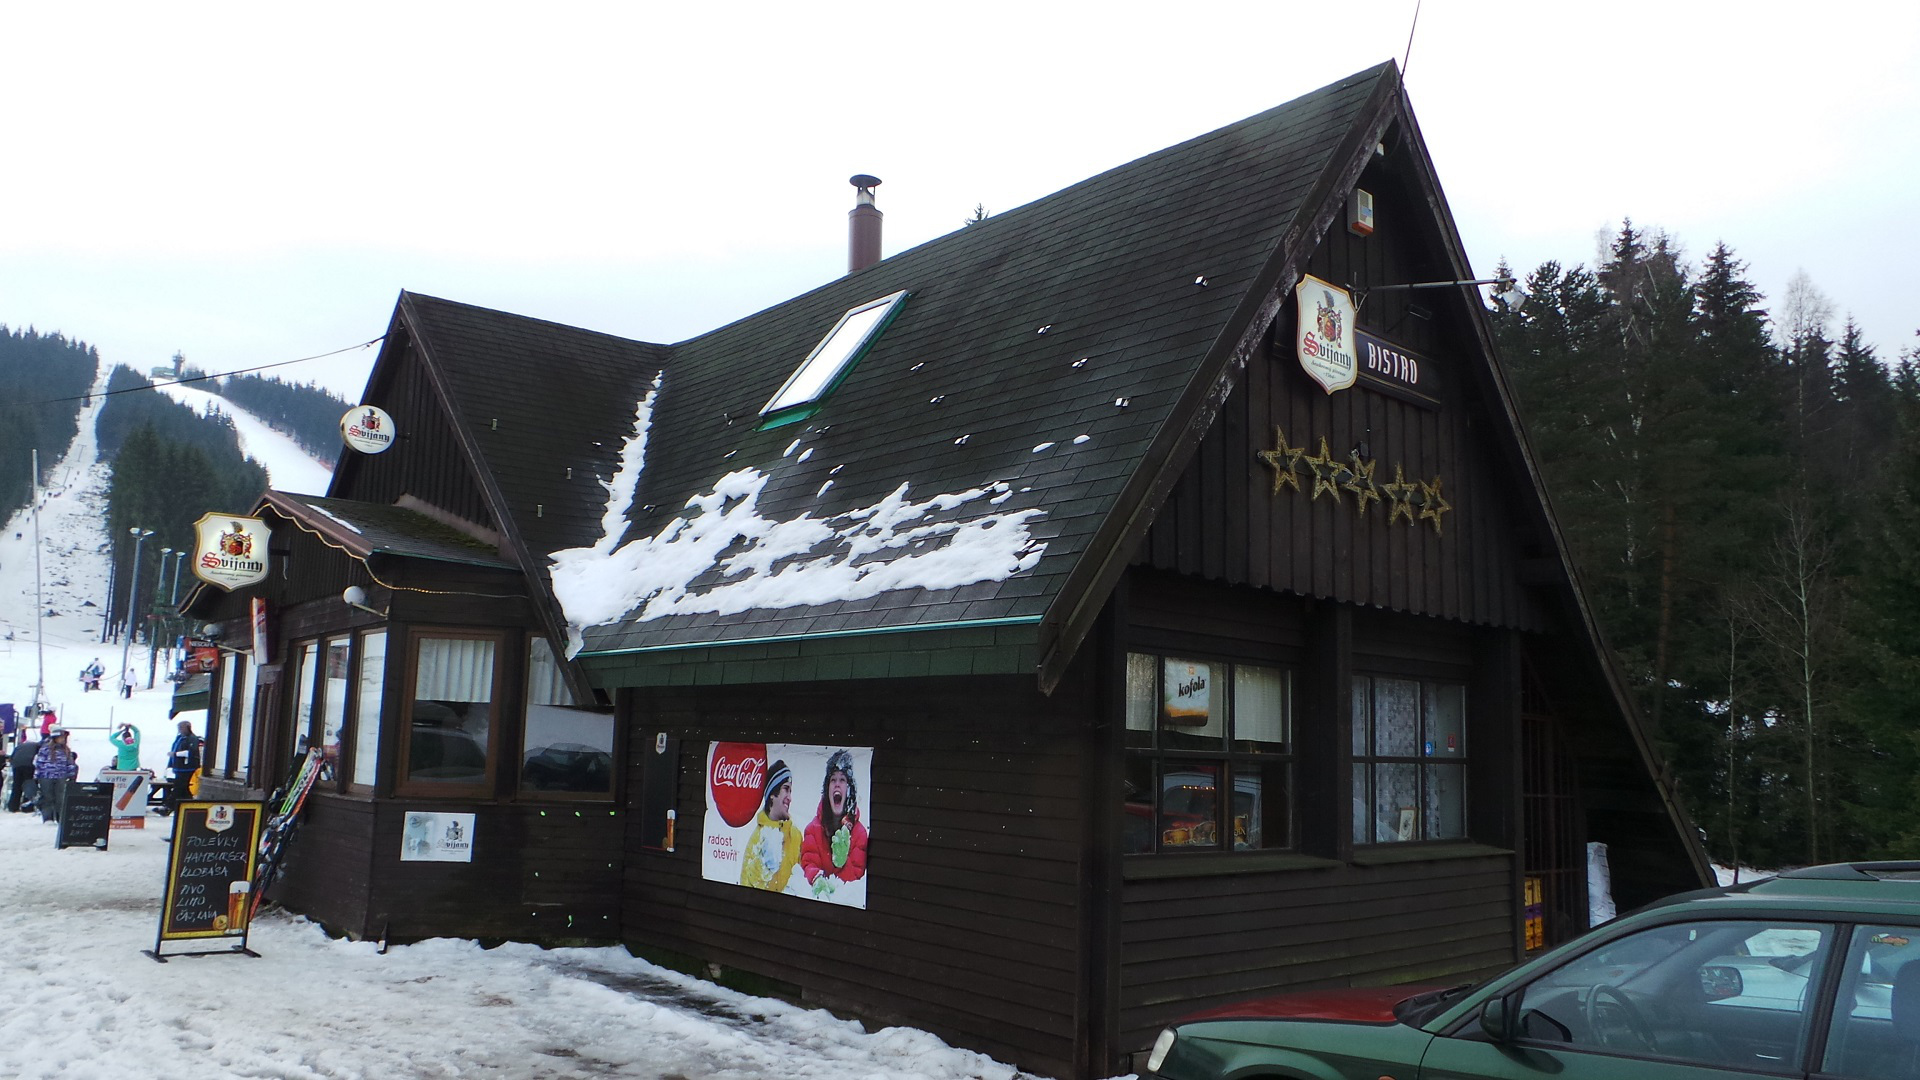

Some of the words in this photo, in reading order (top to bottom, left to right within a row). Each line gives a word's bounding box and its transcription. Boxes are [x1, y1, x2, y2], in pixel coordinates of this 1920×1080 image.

[1303, 331, 1352, 371] Svijany
[1367, 341, 1418, 384] BISTRO
[348, 424, 390, 442] Svijany
[200, 551, 263, 573] Svijany
[1178, 675, 1206, 699] kofola
[713, 756, 766, 789] Coca-Cola
[708, 834, 733, 847] radost
[183, 851, 248, 864] HAMBURGER
